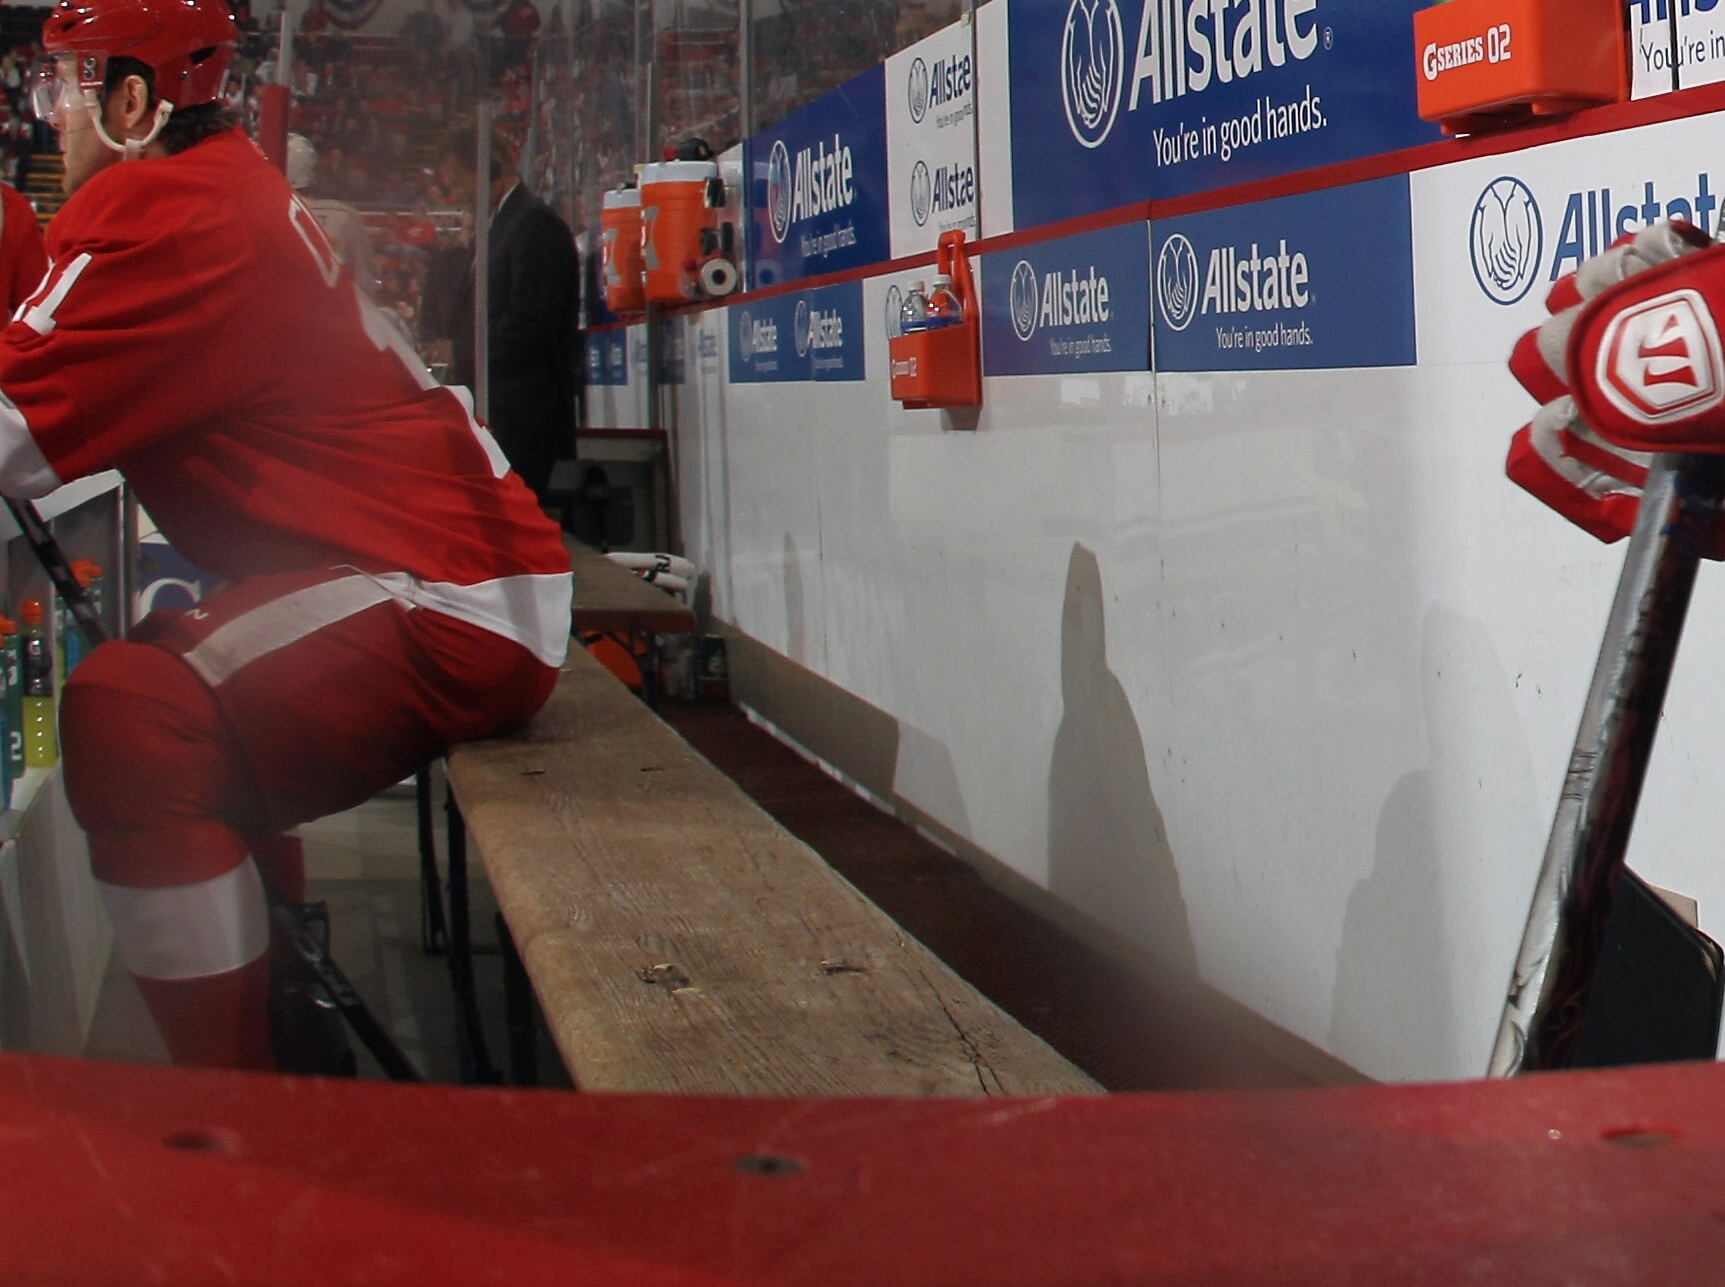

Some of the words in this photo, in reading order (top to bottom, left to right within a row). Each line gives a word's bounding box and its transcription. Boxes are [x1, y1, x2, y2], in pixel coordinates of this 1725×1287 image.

[1487, 23, 1512, 65] 02
[1152, 120, 1200, 167] You're
[1202, 115, 1217, 156] in
[1220, 98, 1263, 162] good
[1266, 83, 1328, 141] hands.
[791, 133, 854, 224] Allstate
[1549, 172, 1717, 282] Allstat
[1039, 265, 1111, 329] Allstate
[1200, 239, 1310, 315] Allstate
[1216, 325, 1244, 350] You're
[1243, 325, 1253, 347] in
[1254, 321, 1279, 353] good
[1279, 320, 1313, 346] hands.
